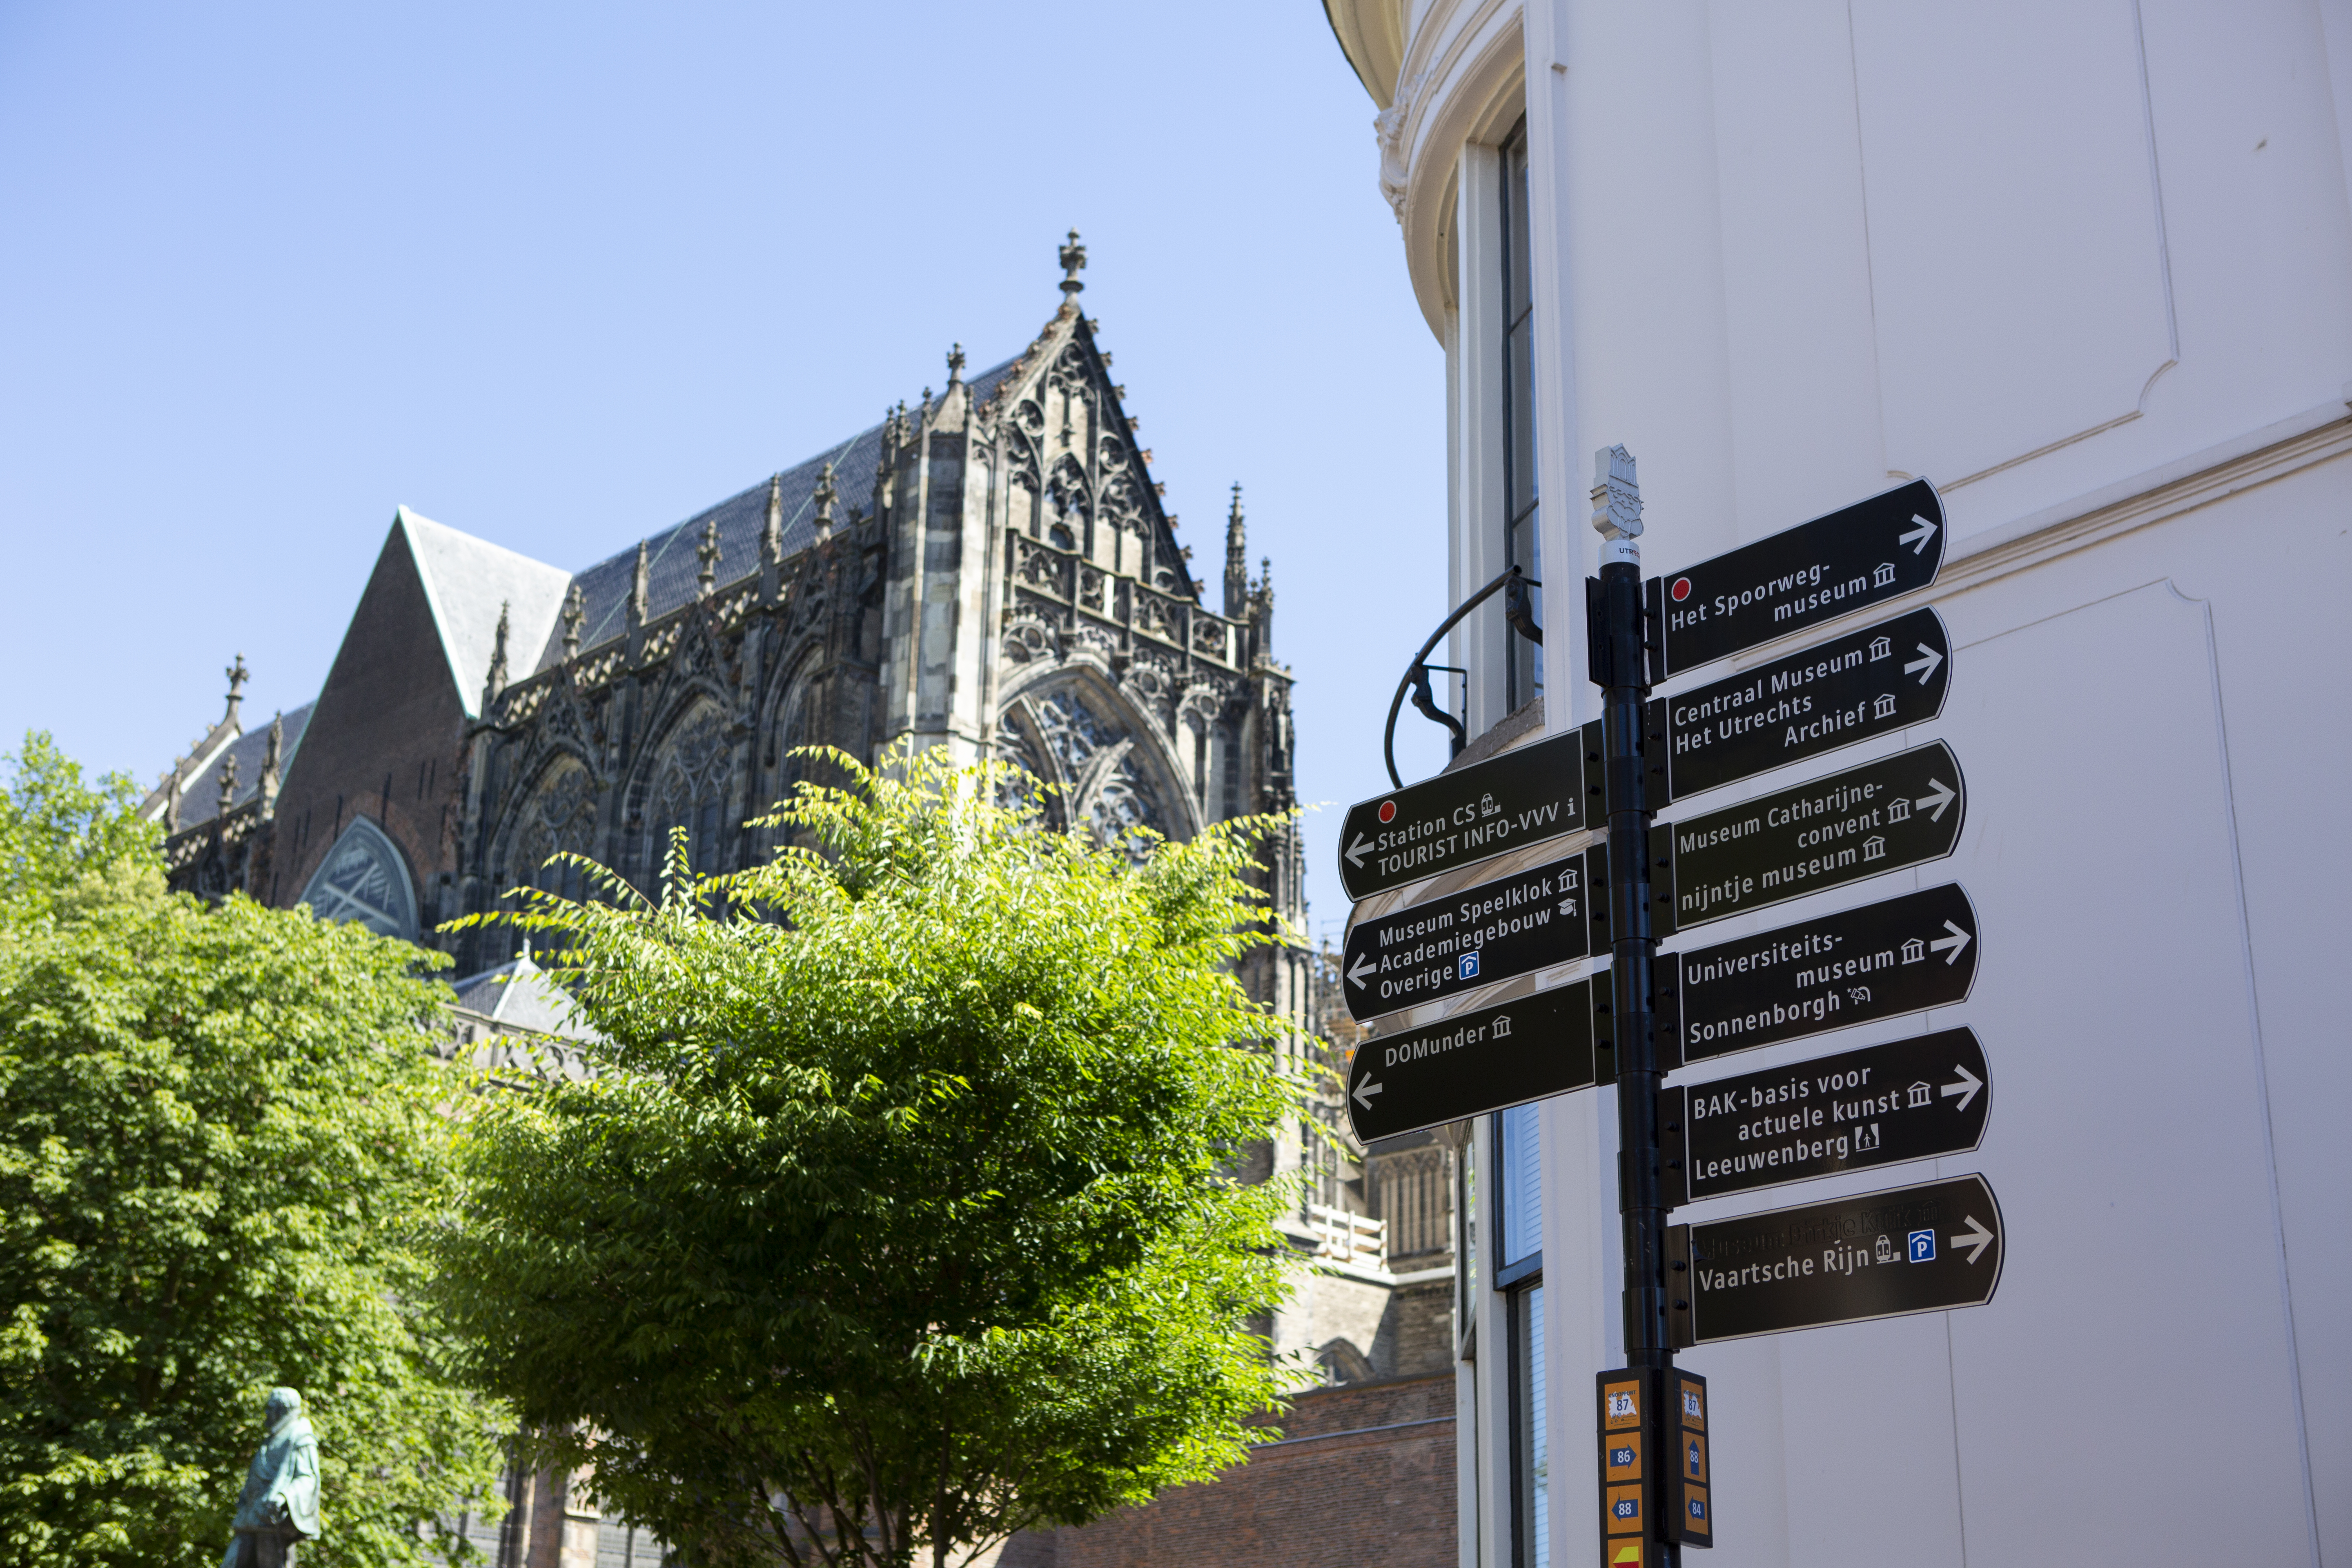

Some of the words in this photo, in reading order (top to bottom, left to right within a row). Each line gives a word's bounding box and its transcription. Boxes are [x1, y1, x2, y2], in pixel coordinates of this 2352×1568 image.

[1619, 548, 1640, 558] UTREC
[1672, 604, 1707, 631] Het
[1715, 564, 1830, 616] Spoorweg-
[1774, 576, 1866, 622] museum
[1675, 679, 1762, 726] Centraal
[1771, 650, 1862, 694] Museum
[1676, 727, 1712, 754] Het
[1719, 696, 1812, 739] Utrechts
[1784, 701, 1866, 747] Archief
[1378, 817, 1445, 851] Station
[1453, 804, 1475, 825] CS
[1378, 835, 1457, 876] TOURIST
[1464, 802, 1559, 849] INFO-VVV
[1681, 818, 1760, 854] Museum
[1768, 784, 1882, 827] Catharijne-
[1798, 808, 1880, 848] convent
[1682, 875, 1753, 911] nijntje
[1762, 848, 1856, 888] museum
[1380, 913, 1453, 947] Museum
[1461, 878, 1552, 924] Speelklok
[1380, 908, 1550, 973] Academiegebouw
[1688, 935, 1842, 984] Universiteits-
[1381, 966, 1452, 998] Overige
[1797, 950, 1894, 988] museum
[1690, 990, 1840, 1043] Sonnenborgh
[1386, 1026, 1486, 1067] DOMunder
[1695, 1078, 1809, 1119] BAK-basis
[1817, 1067, 1871, 1093] voor
[1739, 1106, 1823, 1140] actuele
[1833, 1090, 1900, 1122] kunst
[1696, 1136, 1848, 1180] Leeuwenberg
[1699, 1256, 1813, 1291] Vaartsche
[1824, 1245, 1869, 1275] Rijn
[1608, 1390, 1636, 1398] KNOOPPUNT
[1617, 1399, 1629, 1411] 87
[1688, 1399, 1696, 1411] 87
[1617, 1450, 1630, 1463] 86
[1690, 1450, 1699, 1463] 88
[1619, 1503, 1632, 1515] 88
[1692, 1502, 1701, 1515] 84
